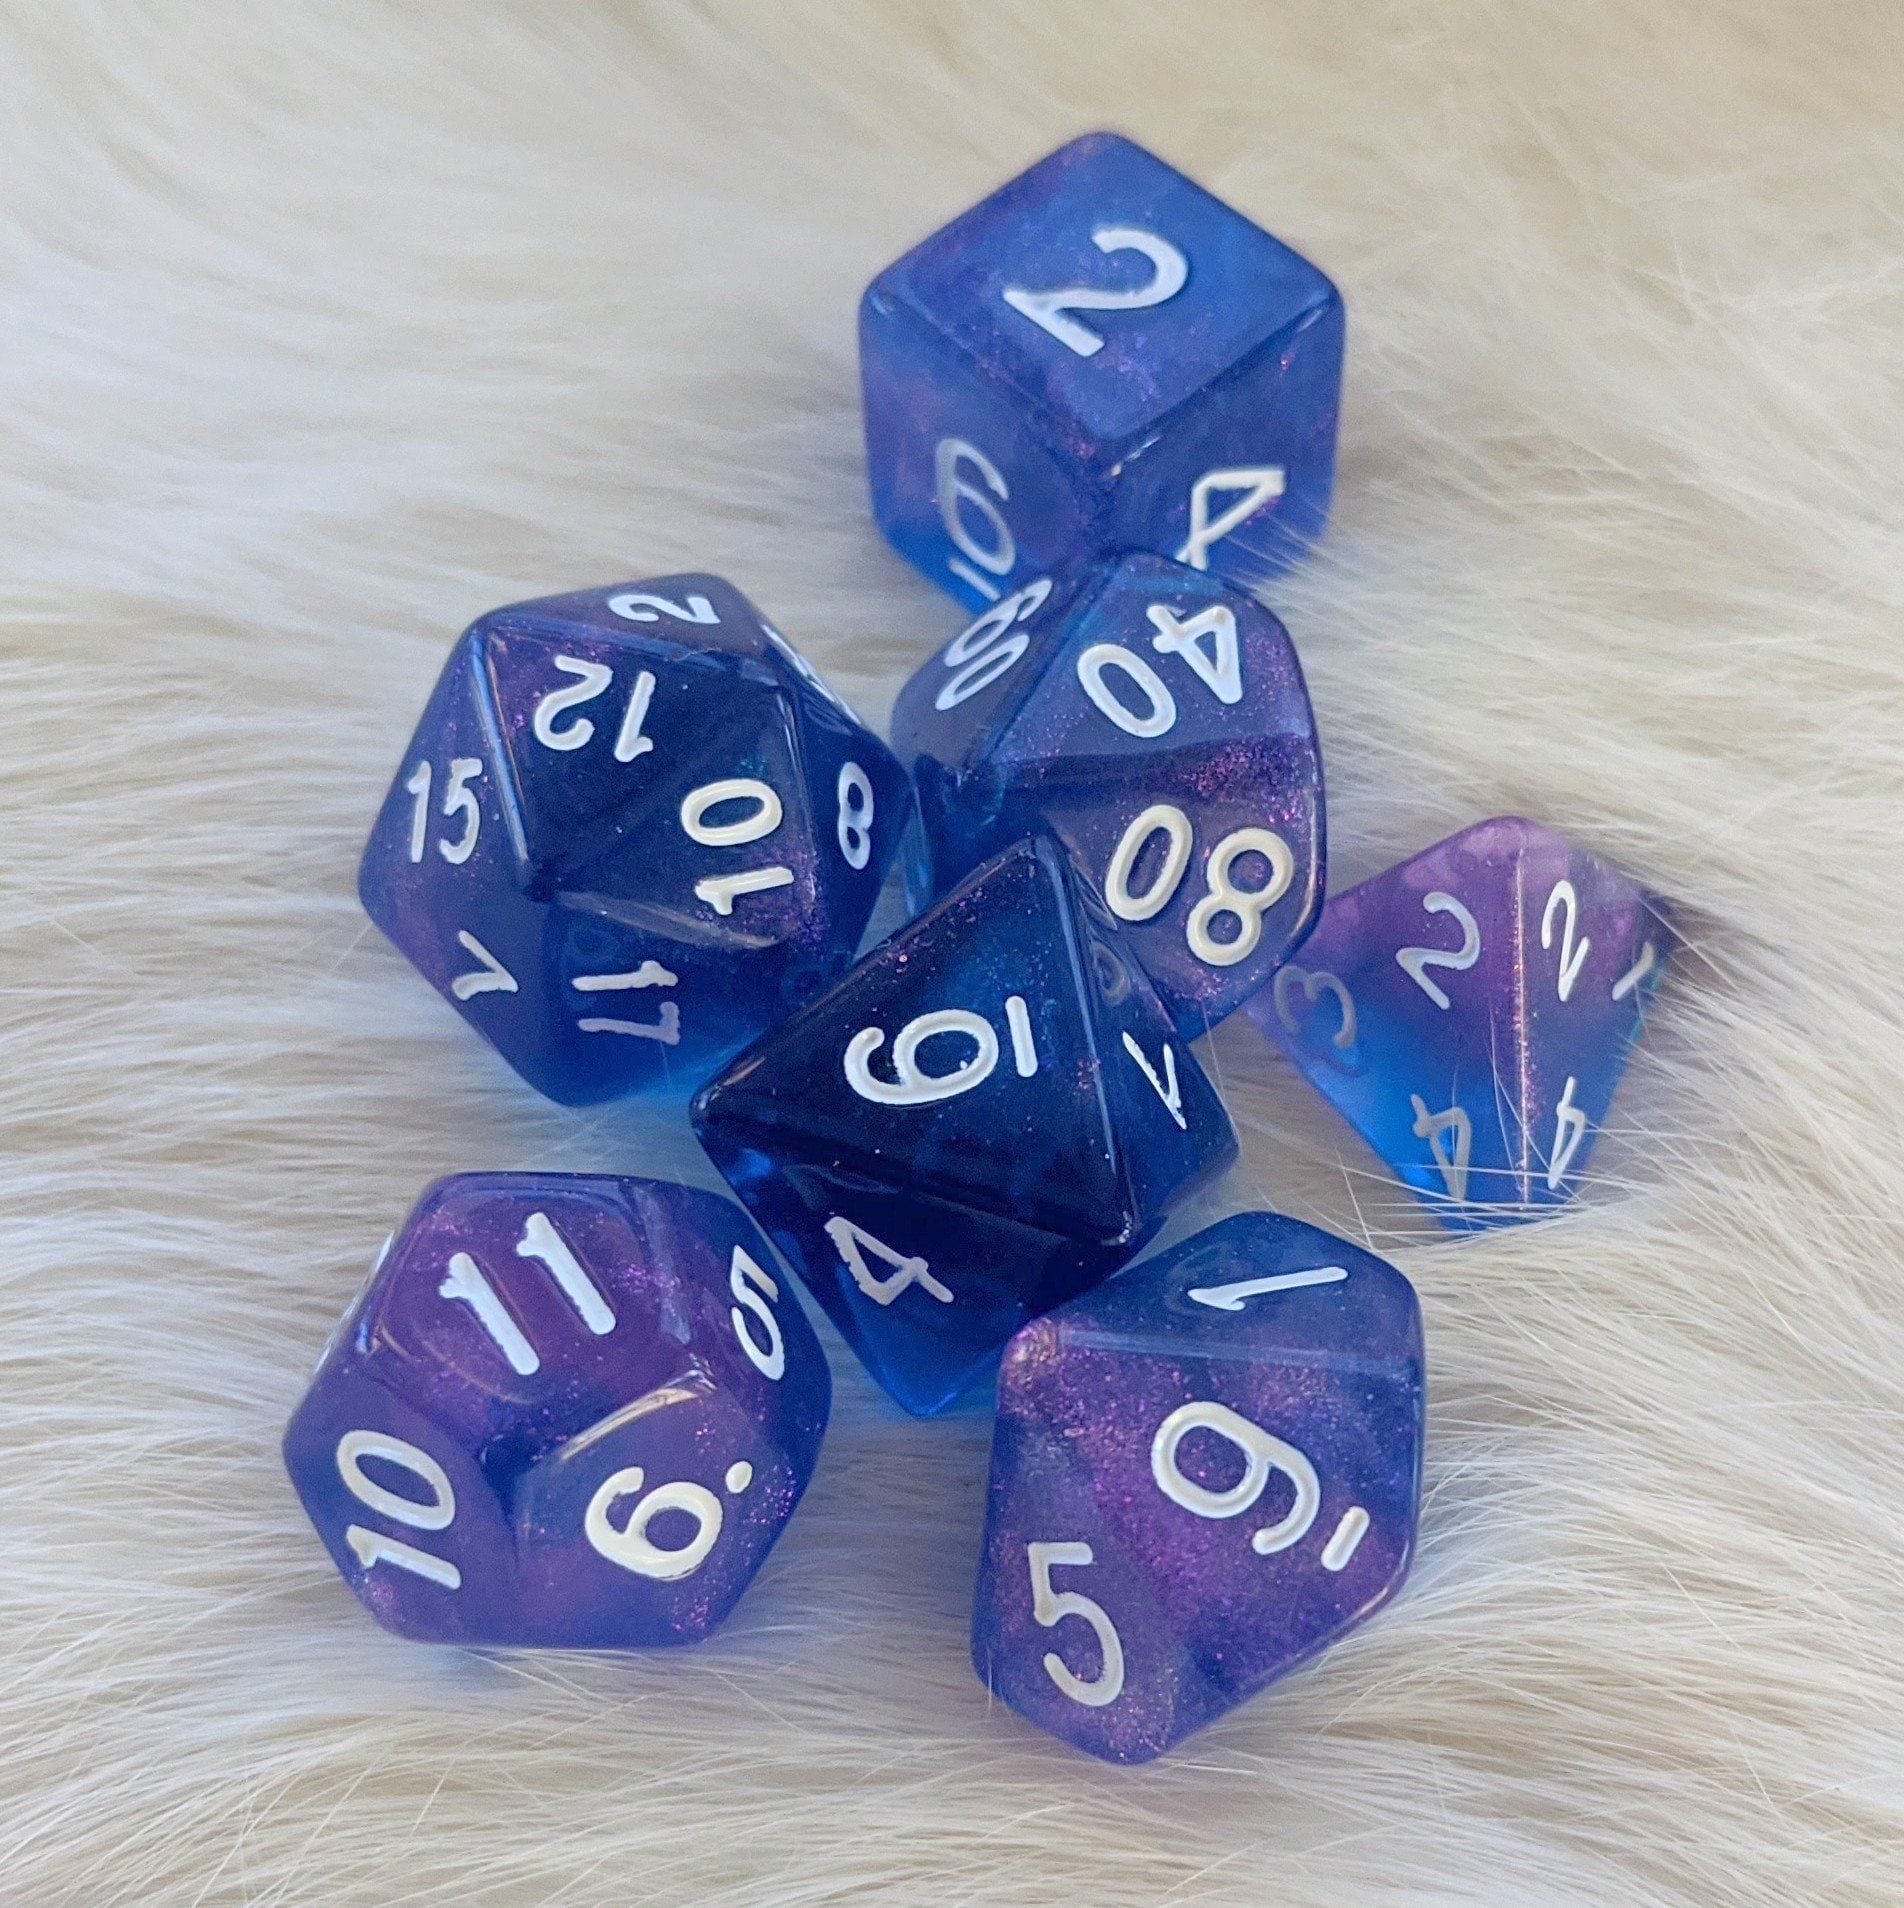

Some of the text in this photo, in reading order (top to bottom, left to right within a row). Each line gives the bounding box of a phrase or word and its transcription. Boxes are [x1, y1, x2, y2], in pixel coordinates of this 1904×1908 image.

[1003, 228, 1187, 357] 2
[1177, 469, 1285, 571] 4
[609, 594, 721, 624] 2
[534, 655, 655, 763] 12
[1077, 604, 1243, 738] 40
[408, 758, 482, 865] 15
[681, 778, 794, 915] 10
[838, 761, 874, 870] 8
[1105, 804, 1294, 966] 80
[451, 931, 519, 1000] 7
[1396, 892, 1480, 1009] 2
[1542, 880, 1589, 1001] 2
[572, 960, 680, 1045] 17
[1274, 966, 1356, 1048] 3
[1411, 1094, 1470, 1202] 4
[1548, 1077, 1586, 1189] 4
[440, 1212, 616, 1375] 11
[730, 1244, 784, 1380] 5
[825, 1216, 954, 1305] 4
[1188, 1267, 1348, 1311] 1
[336, 1430, 462, 1590] 10
[1027, 1541, 1125, 1706] 5
